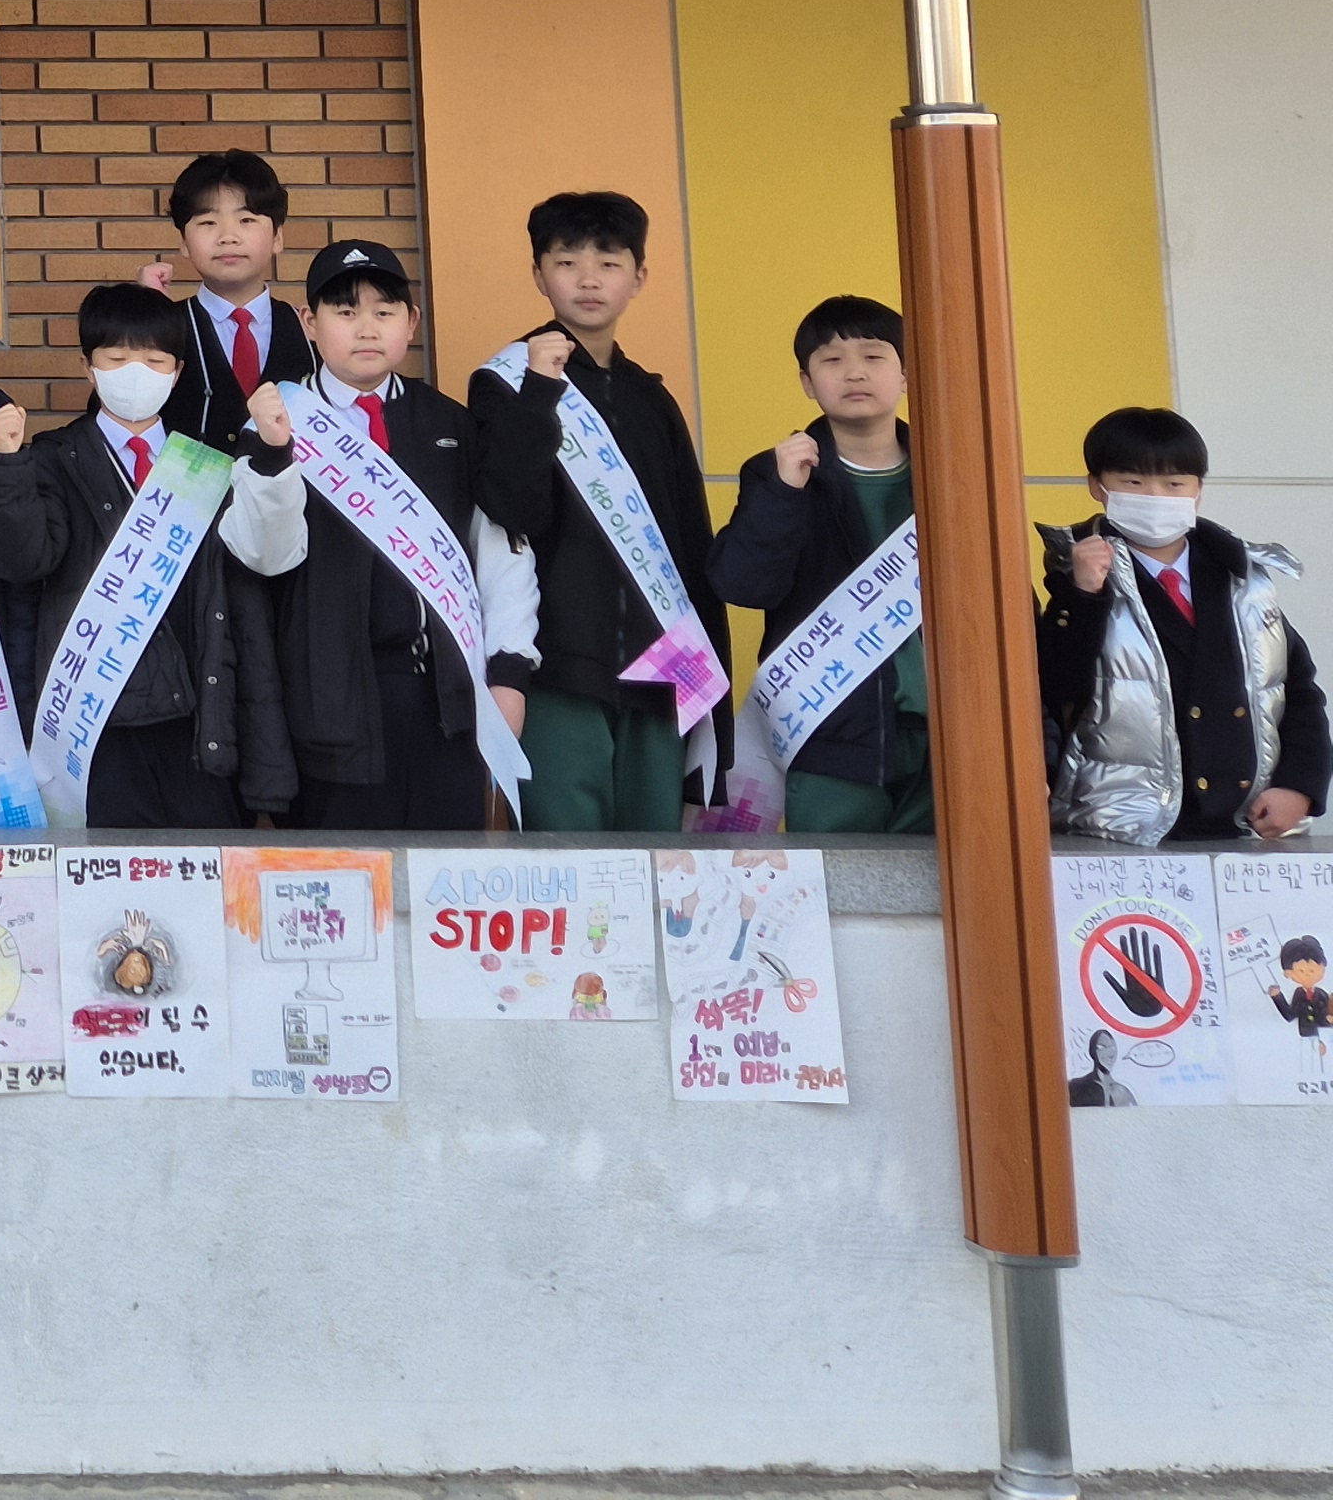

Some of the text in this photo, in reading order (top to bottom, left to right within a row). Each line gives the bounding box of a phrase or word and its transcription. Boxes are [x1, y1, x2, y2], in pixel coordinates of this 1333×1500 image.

[307, 400, 419, 517] 하루친구
[388, 527, 476, 648] 십년간다
[32, 488, 173, 741] 서로서로 어깨짐을
[753, 611, 844, 716] 밝은학교
[766, 660, 853, 758] 친구사랑
[66, 692, 103, 781] 친구들
[66, 857, 122, 886] 당신의
[426, 858, 647, 905] 사이버 폭력
[1066, 857, 1128, 880] 나에겐
[1138, 878, 1178, 900] 상처
[1224, 862, 1271, 893] 안전한
[1278, 862, 1302, 889] 학교
[429, 907, 569, 956] STOP!
[1073, 899, 1195, 941] DON'T TOUCH ME
[191, 1004, 210, 1032] 수
